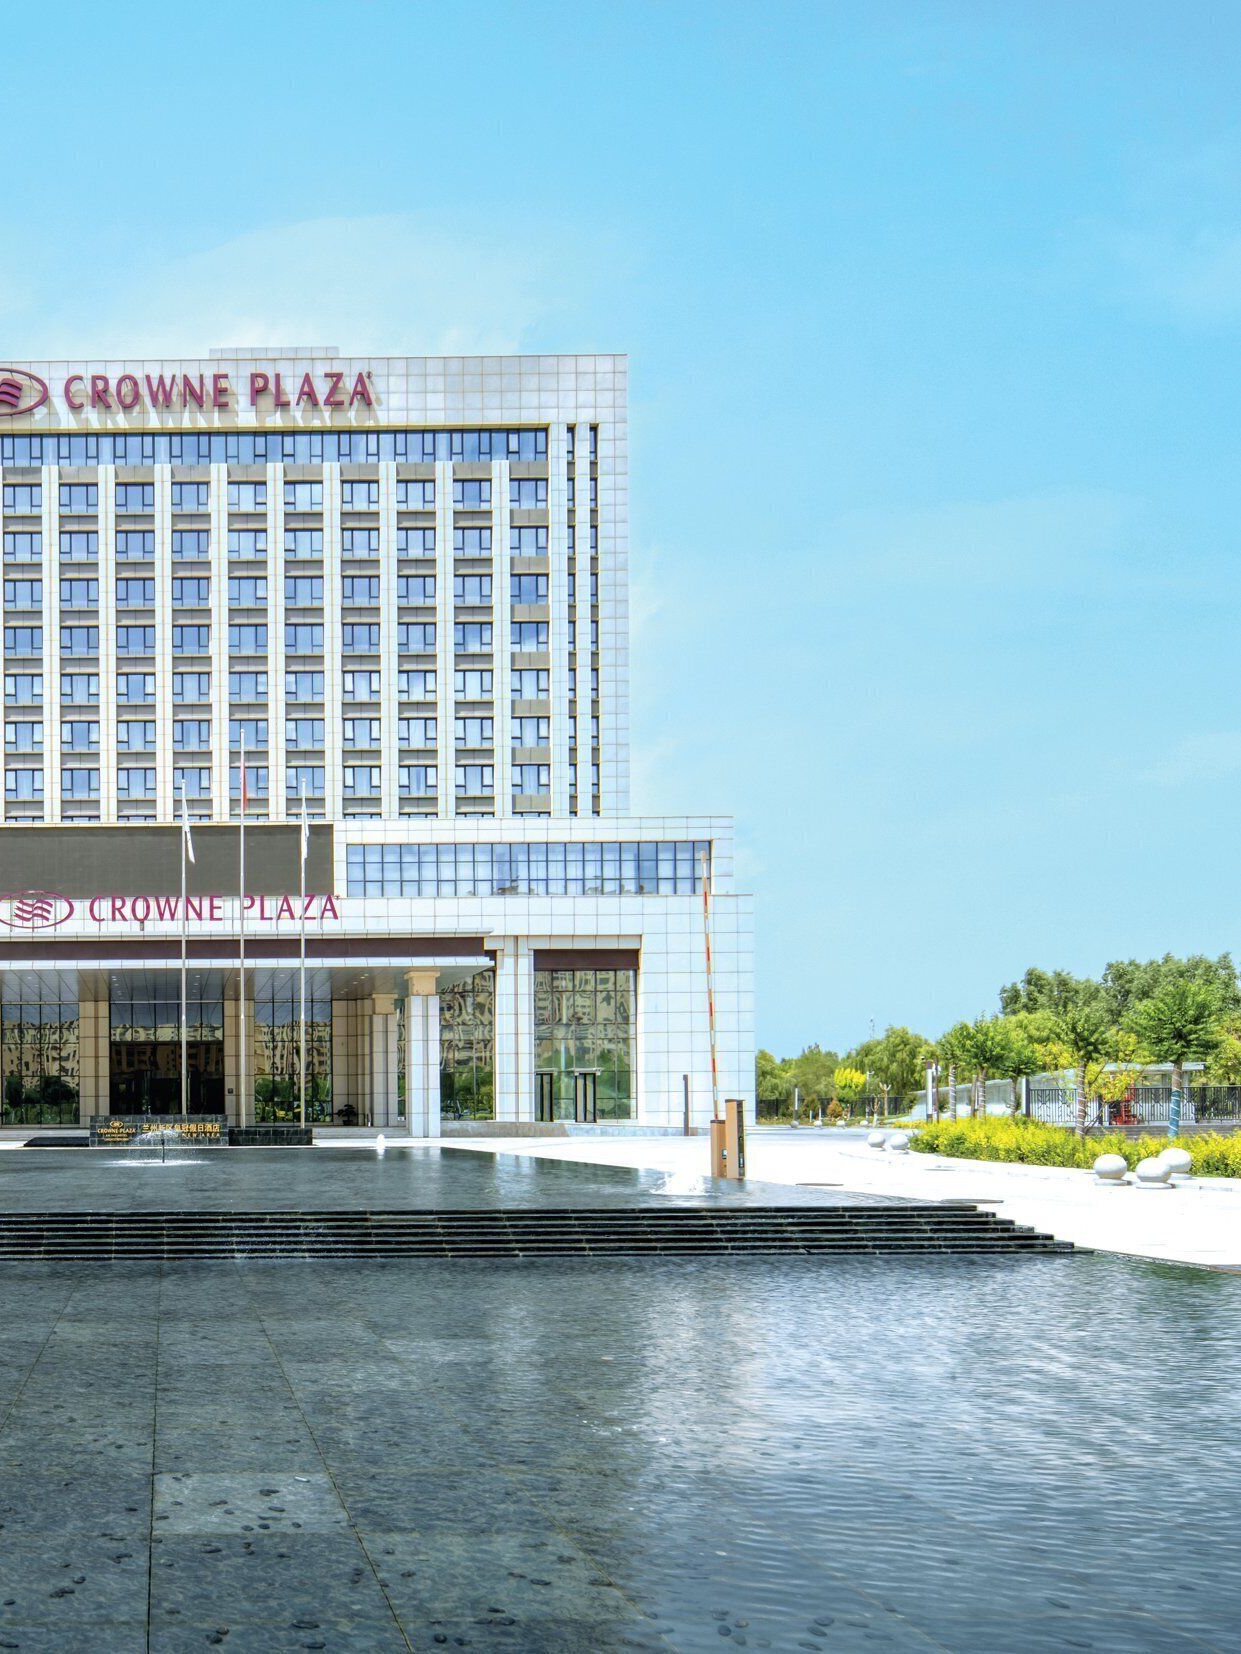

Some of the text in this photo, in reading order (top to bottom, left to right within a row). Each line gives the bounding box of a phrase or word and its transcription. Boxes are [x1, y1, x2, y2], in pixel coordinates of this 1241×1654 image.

[64, 372, 372, 408] CROWNE PLAZA
[89, 894, 339, 922] CROWNE PLAZA
